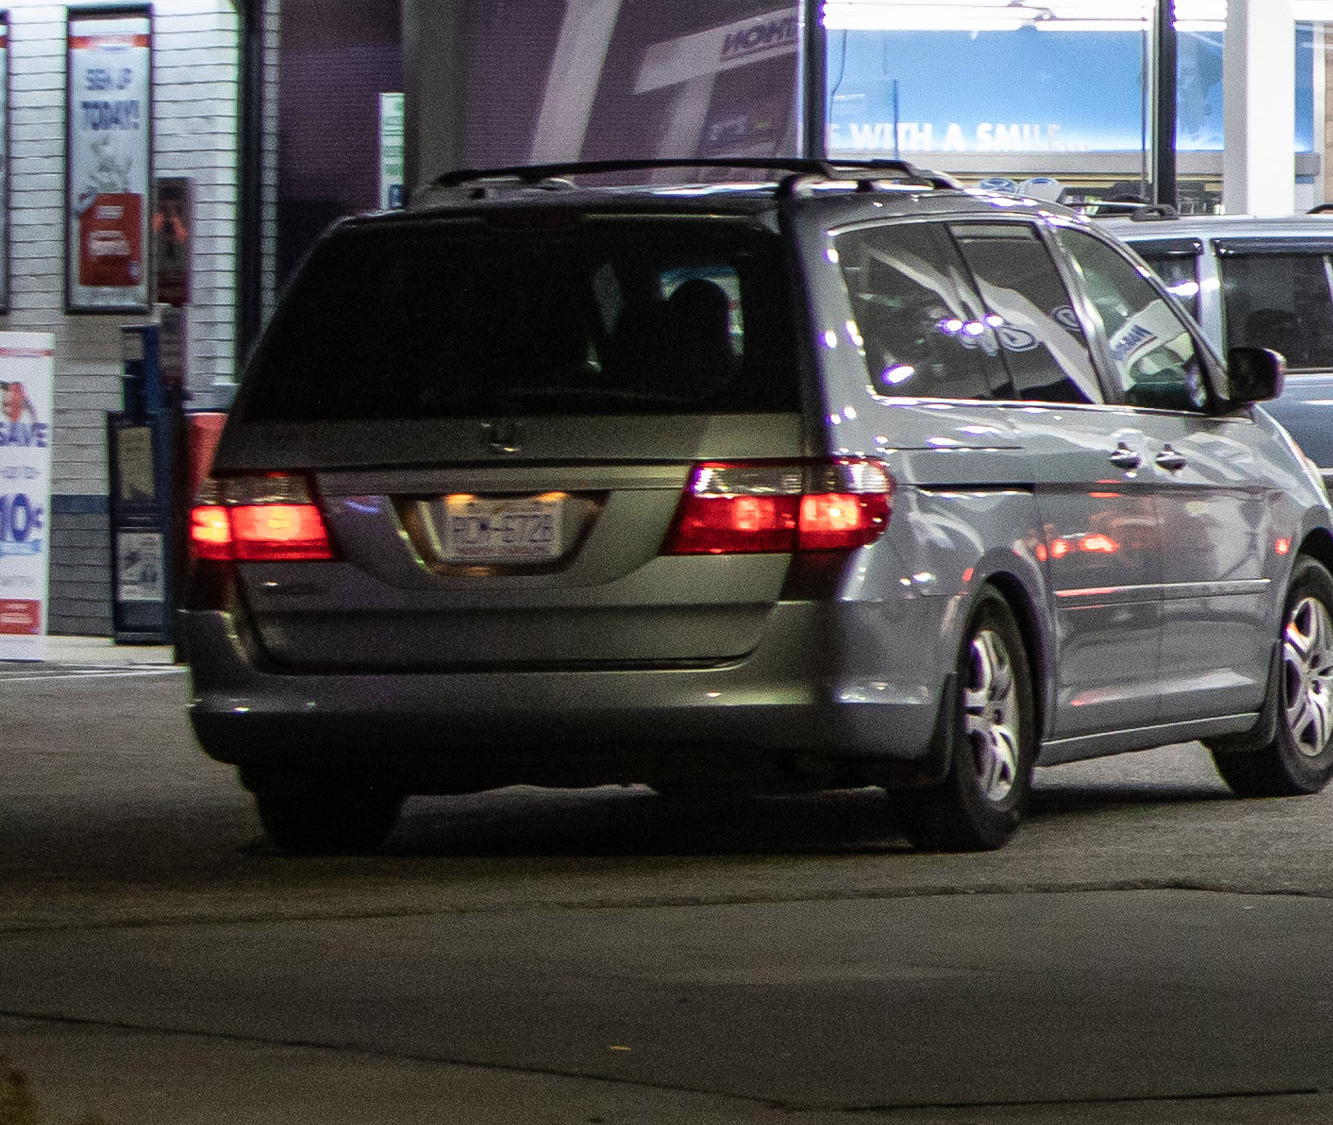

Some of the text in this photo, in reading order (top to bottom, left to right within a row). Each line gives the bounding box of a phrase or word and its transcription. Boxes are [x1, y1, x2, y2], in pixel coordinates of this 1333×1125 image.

[82, 99, 140, 131] TODAY!
[850, 122, 933, 150] WITH
[943, 122, 966, 151] A
